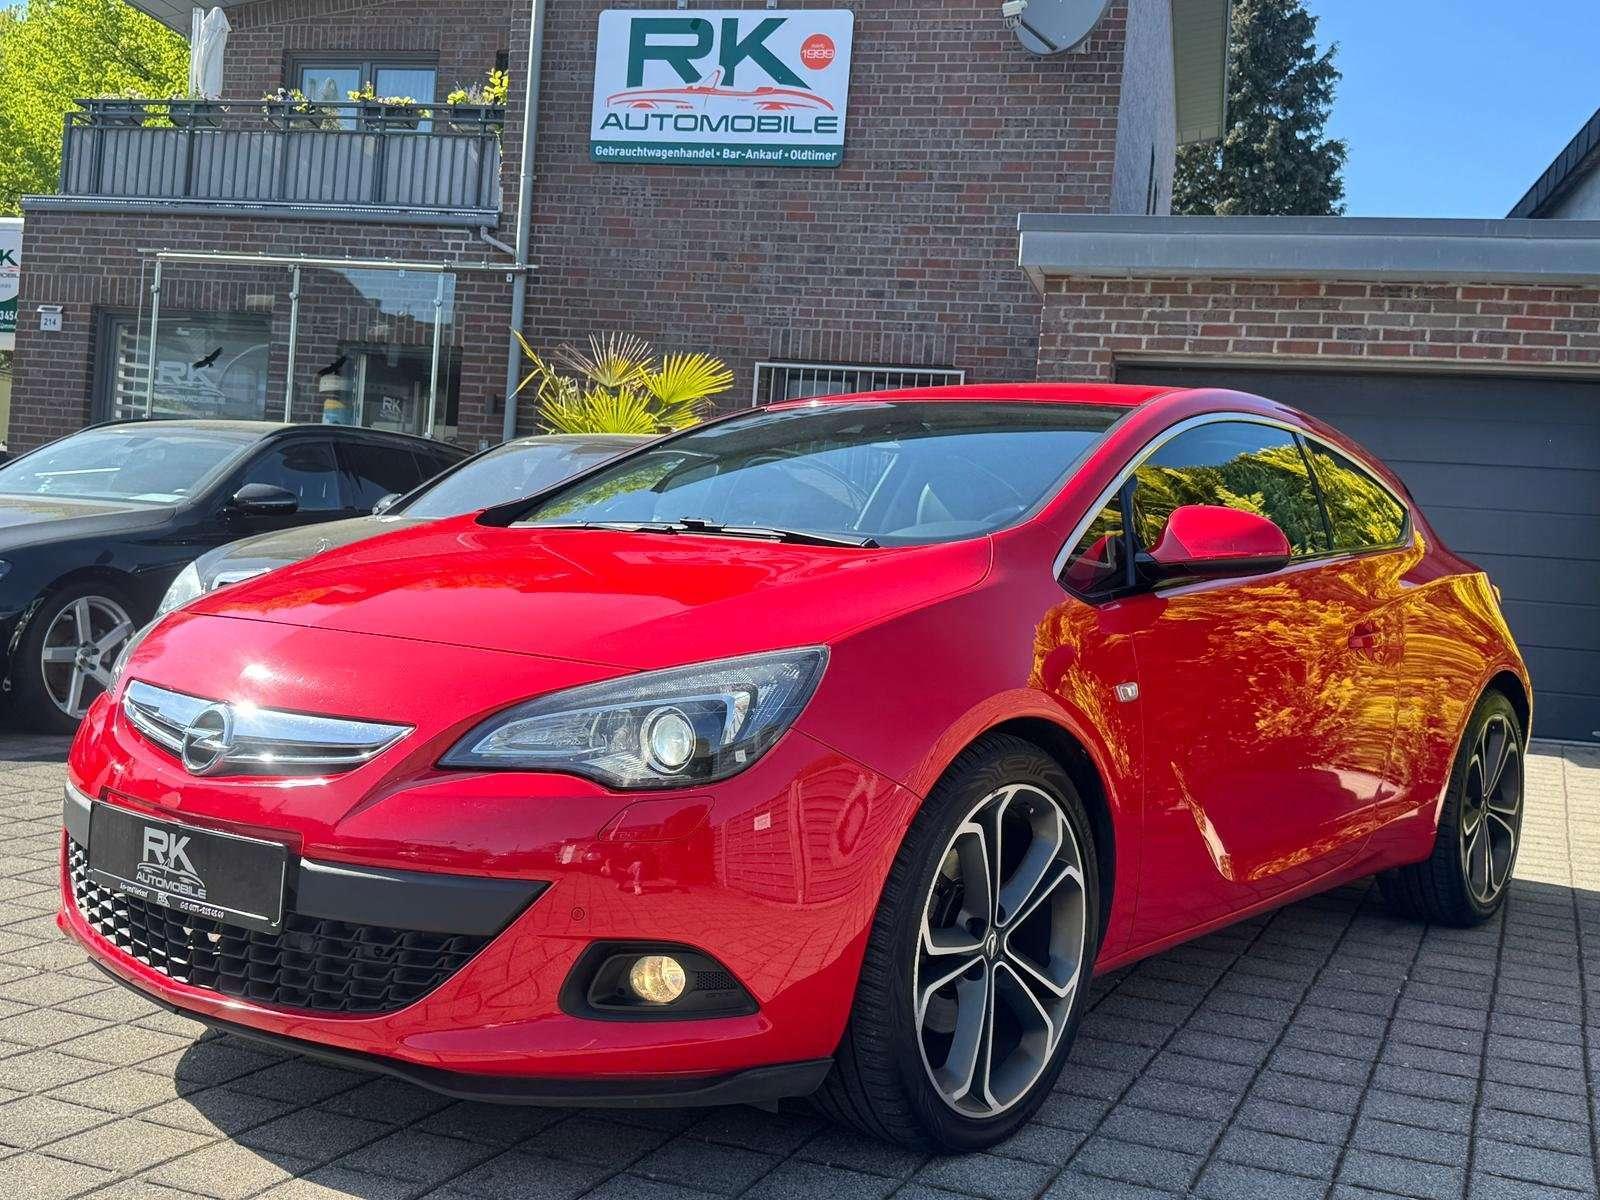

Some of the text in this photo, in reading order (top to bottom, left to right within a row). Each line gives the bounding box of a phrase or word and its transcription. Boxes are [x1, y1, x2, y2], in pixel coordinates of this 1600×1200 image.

[626, 17, 812, 90] RK
[600, 112, 838, 134] AUTOMOBILE
[595, 146, 837, 161] Gebrauchtwagenhandel Bar-Ankauf Oldtimer
[143, 826, 199, 877] RK
[135, 871, 207, 900] AUTOMOBILE
